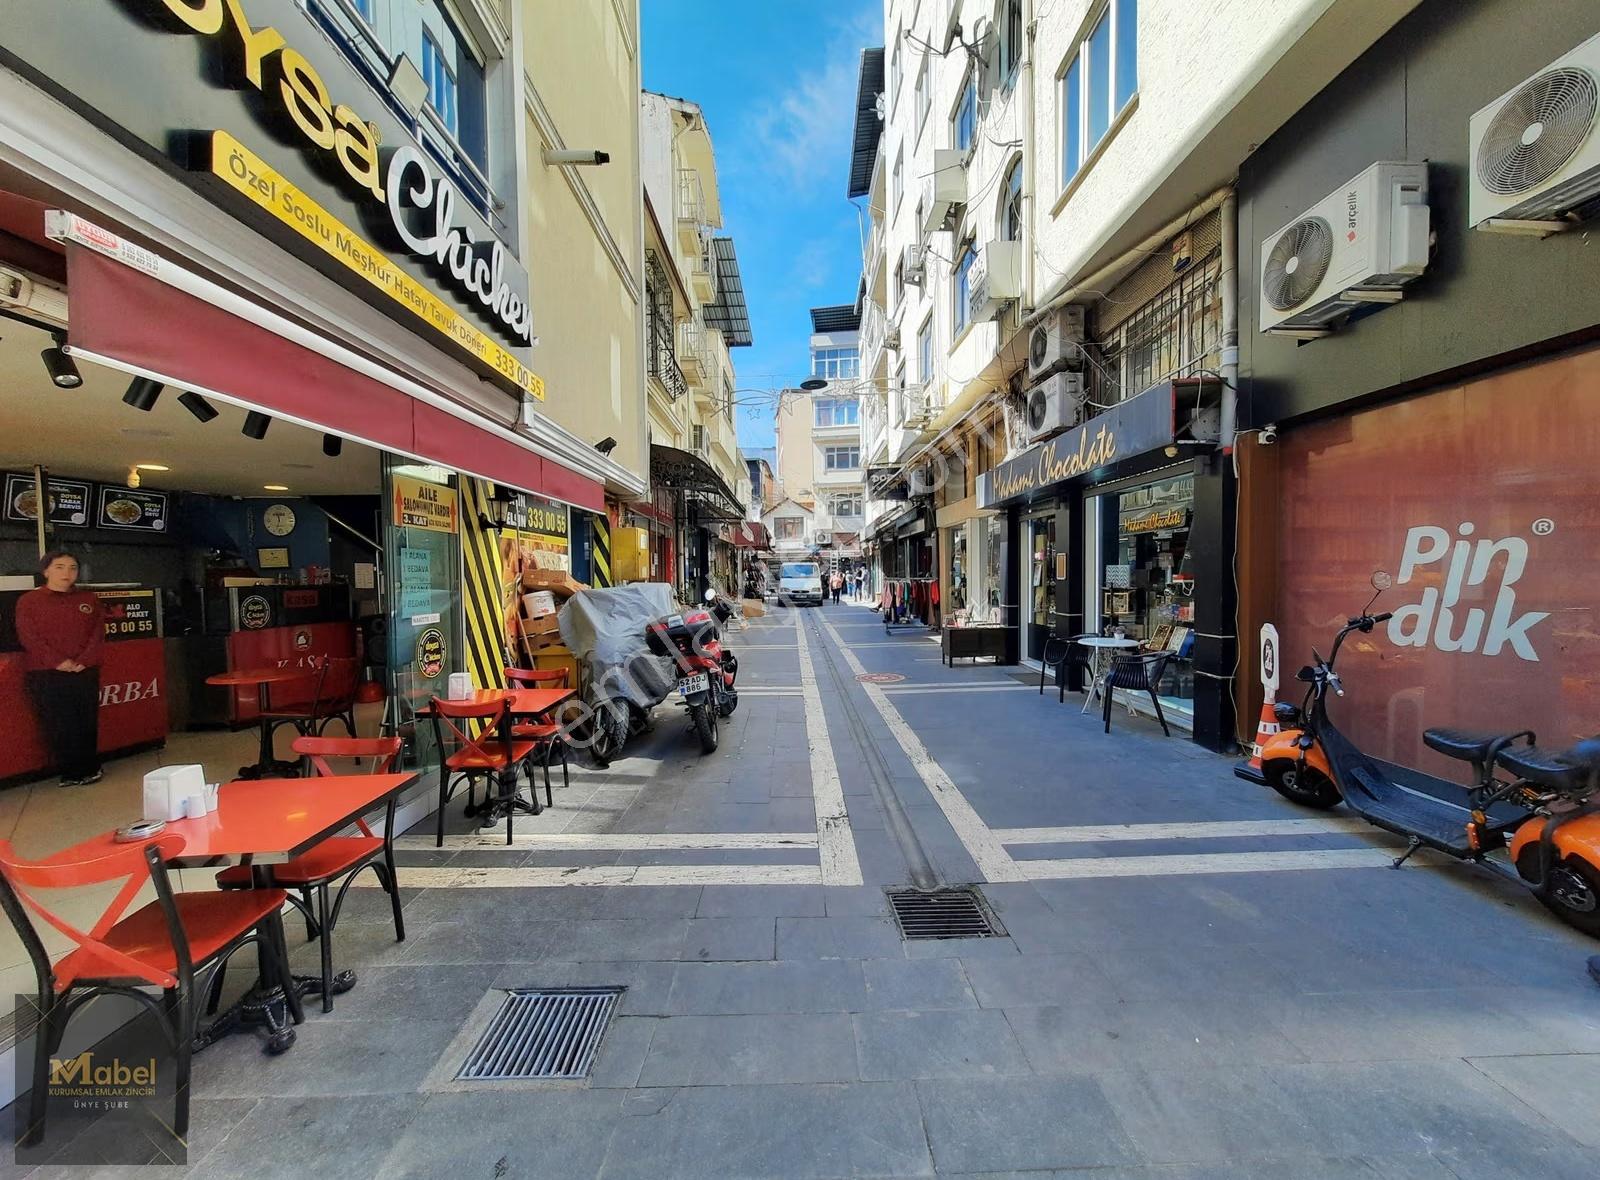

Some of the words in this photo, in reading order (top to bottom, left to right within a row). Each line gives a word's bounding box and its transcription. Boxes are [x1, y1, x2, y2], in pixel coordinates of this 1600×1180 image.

[229, 148, 276, 203] Özel
[282, 192, 330, 242] Soslu
[335, 231, 391, 284] Meşhur
[394, 275, 428, 313] Hatay
[430, 302, 458, 335] Tavuk
[460, 326, 487, 355] Döneri
[495, 348, 514, 377] 333
[517, 364, 529, 388] 00
[530, 375, 541, 397] 55
[1038, 423, 1117, 486] Chocolate
[418, 485, 438, 502] AİLE
[403, 514, 412, 524] 3.
[413, 515, 428, 526] KAT
[527, 506, 544, 530] 333
[545, 511, 556, 532] 00
[556, 514, 567, 534] 55
[121, 622, 136, 632] 00
[138, 620, 153, 631] 55
[1386, 585, 1552, 662] duk
[98, 677, 160, 707] RBA
[680, 679, 690, 687] 52
